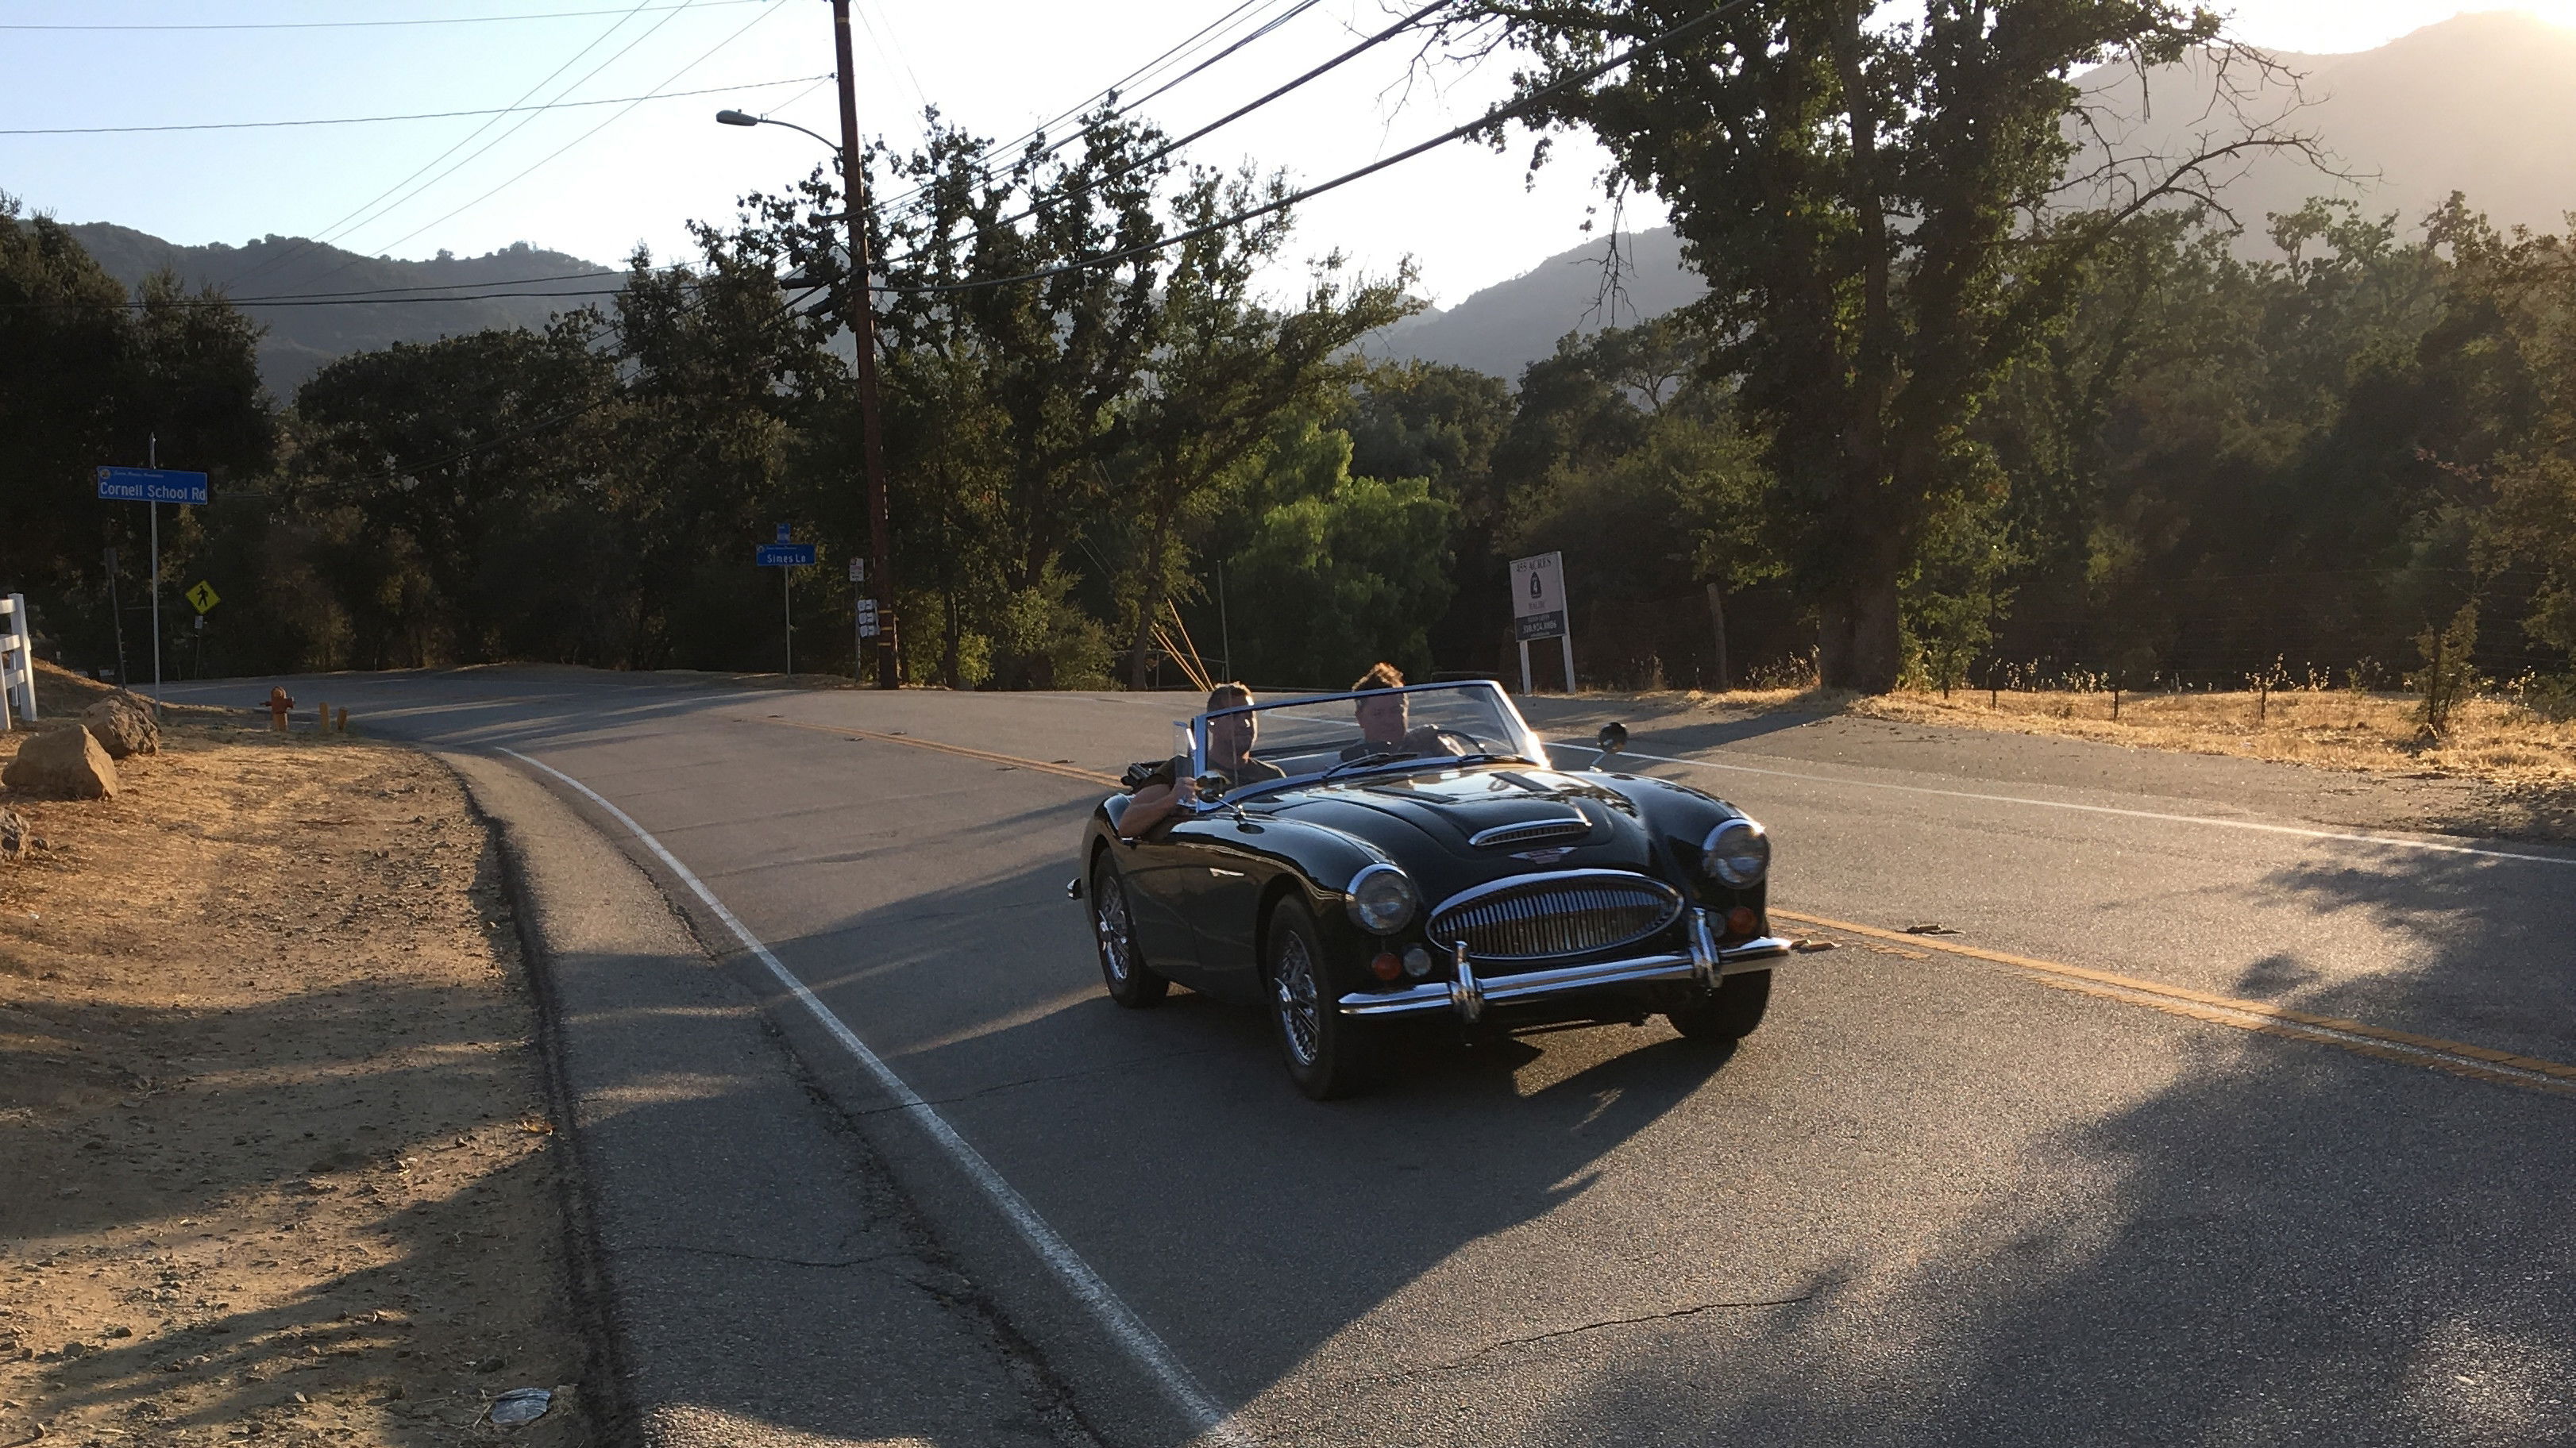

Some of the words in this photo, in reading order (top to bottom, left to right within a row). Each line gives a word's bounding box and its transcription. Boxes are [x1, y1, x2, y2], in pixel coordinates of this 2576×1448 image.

[100, 481, 143, 497] Cornell
[147, 484, 187, 499] School
[191, 487, 206, 501] Rd
